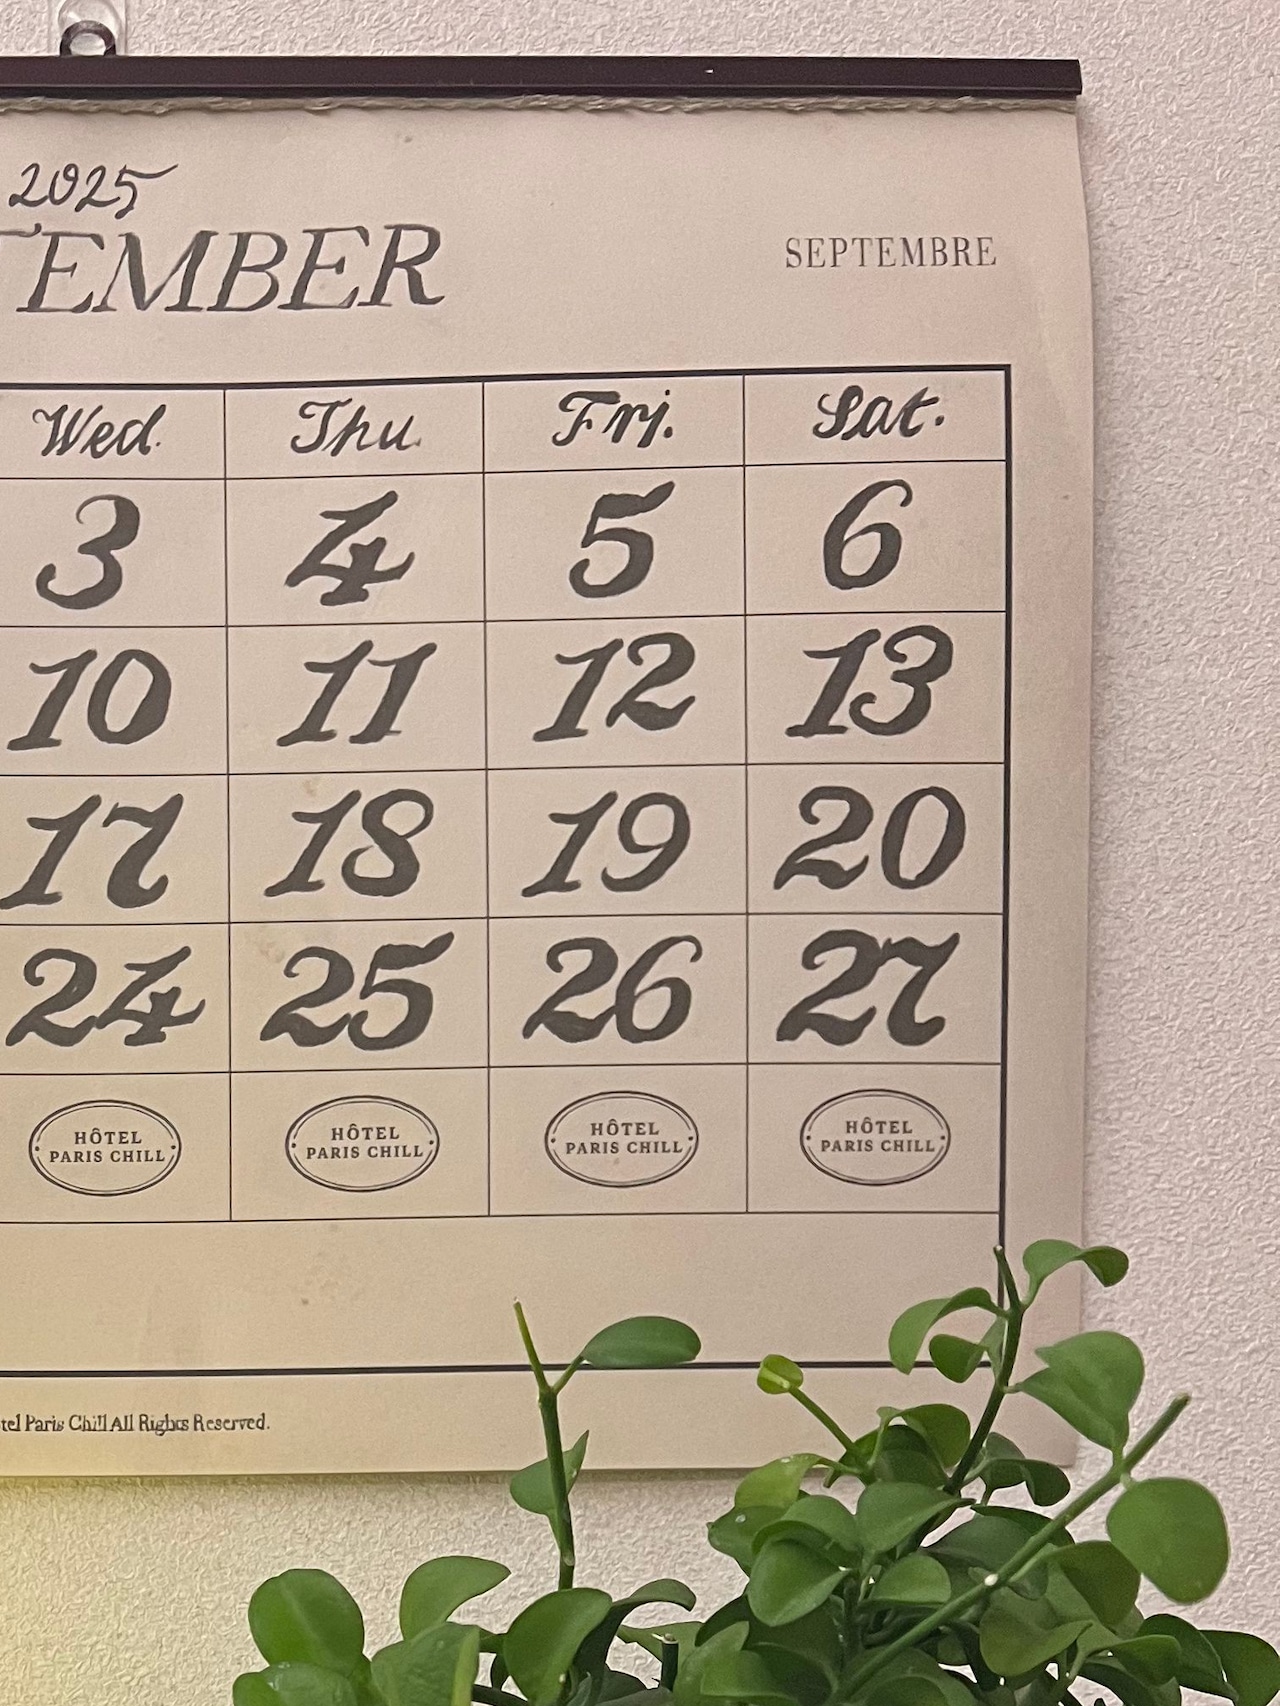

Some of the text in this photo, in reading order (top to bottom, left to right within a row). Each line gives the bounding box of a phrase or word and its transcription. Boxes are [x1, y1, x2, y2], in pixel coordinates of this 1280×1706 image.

[9, 163, 178, 219] 2025
[786, 237, 996, 268] SEPTEMBRE
[813, 385, 944, 440] Sat.
[36, 495, 140, 610] 3
[285, 491, 414, 606] 4
[569, 481, 675, 598] 5
[823, 480, 912, 590] 6
[7, 649, 171, 751] 10
[277, 640, 437, 747] 11
[533, 632, 695, 742] 12
[785, 625, 953, 738] 13
[264, 789, 433, 897] 18
[522, 791, 690, 897] 19
[774, 786, 966, 890] 20
[5, 946, 205, 1047] 24
[260, 932, 454, 1051] 25
[522, 935, 702, 1043] 26
[776, 929, 960, 1046] 27
[332, 1123, 399, 1140] HÔTEL
[591, 1119, 659, 1136] HÔTEL
[846, 1117, 912, 1134] HÔTEL
[75, 1128, 141, 1144] HÔTEL
[822, 1140, 935, 1152] PARIS CHILL
[50, 1150, 165, 1162] PARIS CHILL
[307, 1145, 423, 1159] PARIS CHILL
[566, 1141, 682, 1154] PARIS CHILL
[25, 1414, 64, 1431] Paris
[69, 1414, 107, 1432] Chill
[110, 1414, 134, 1432] All
[139, 1414, 189, 1436] Rights
[194, 1413, 269, 1431] Reserved.
